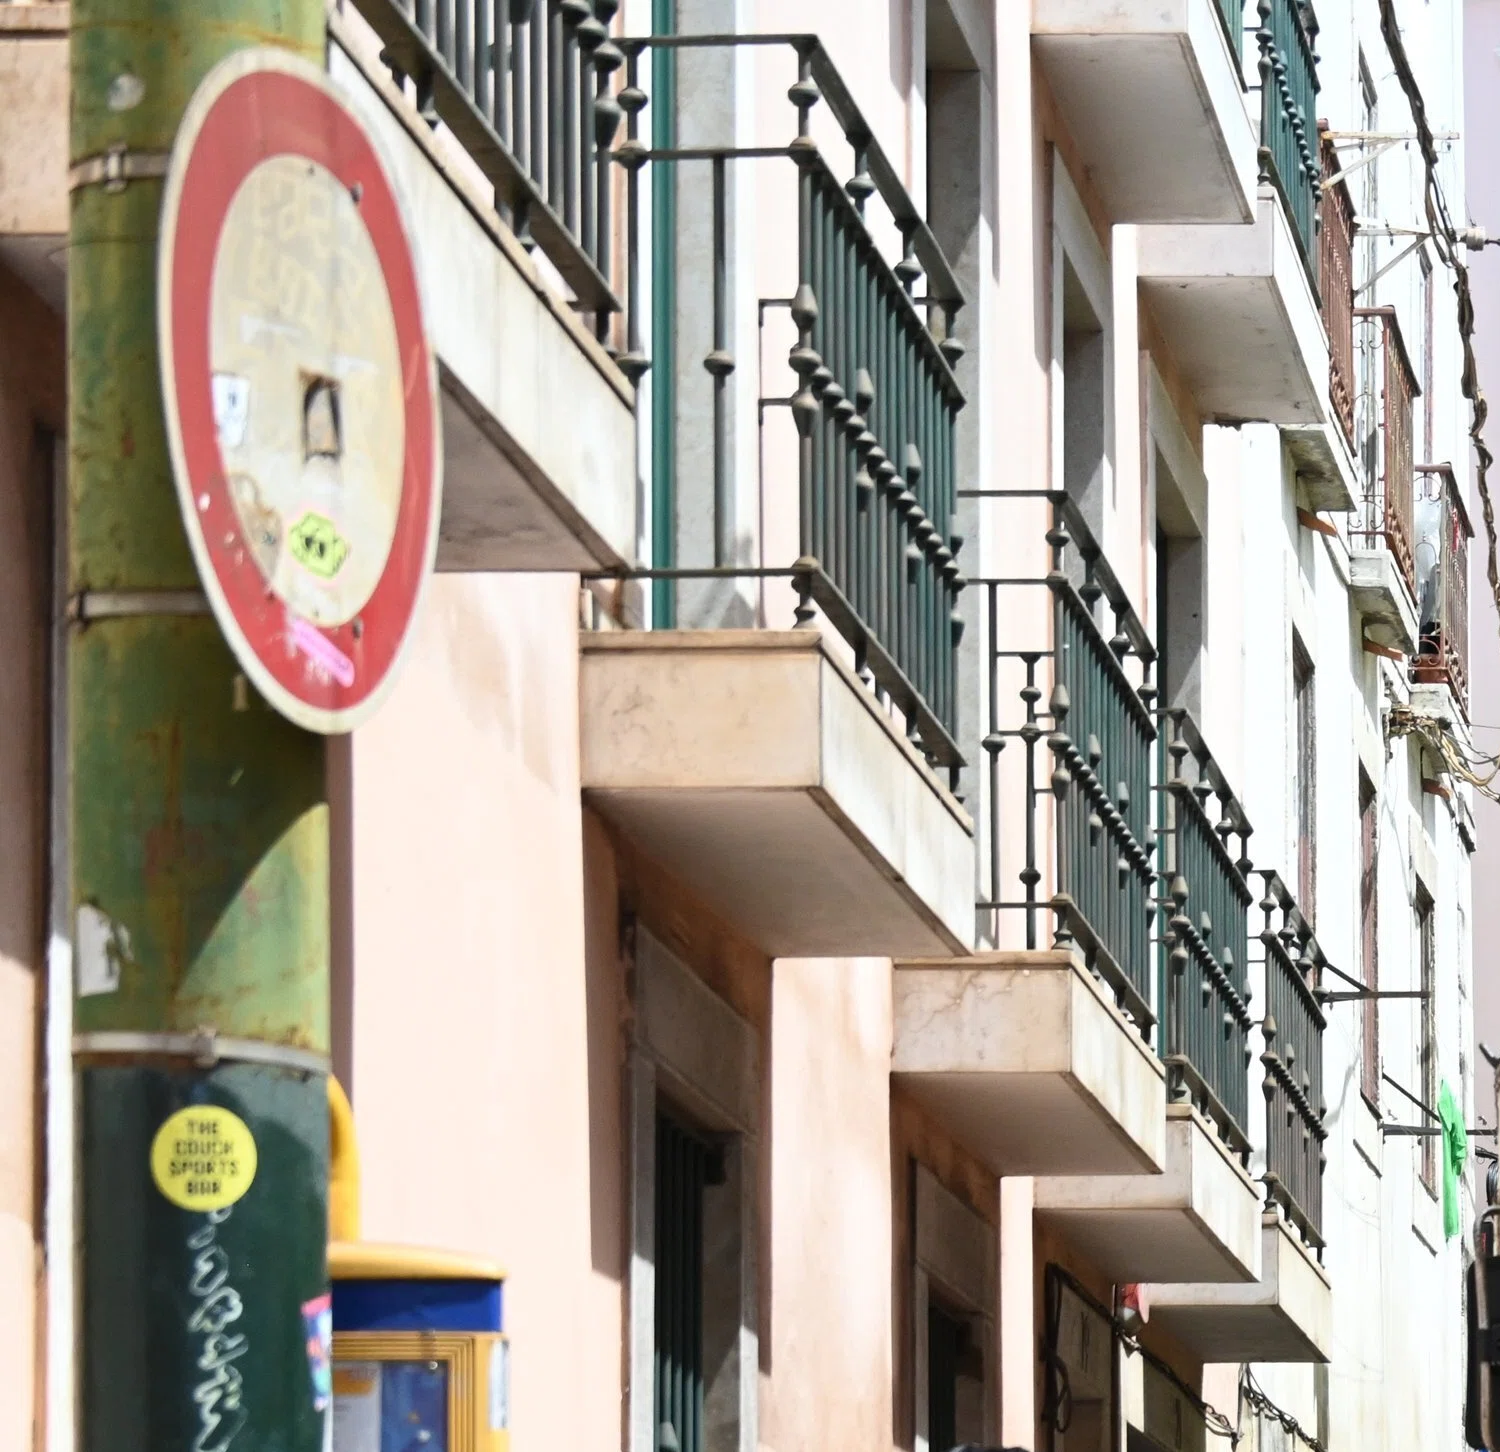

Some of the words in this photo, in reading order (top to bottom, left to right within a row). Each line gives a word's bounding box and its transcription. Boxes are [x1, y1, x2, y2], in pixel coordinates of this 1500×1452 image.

[187, 1119, 218, 1134] THE
[169, 1161, 238, 1177] SPORTS
[187, 1181, 220, 1195] BAR
